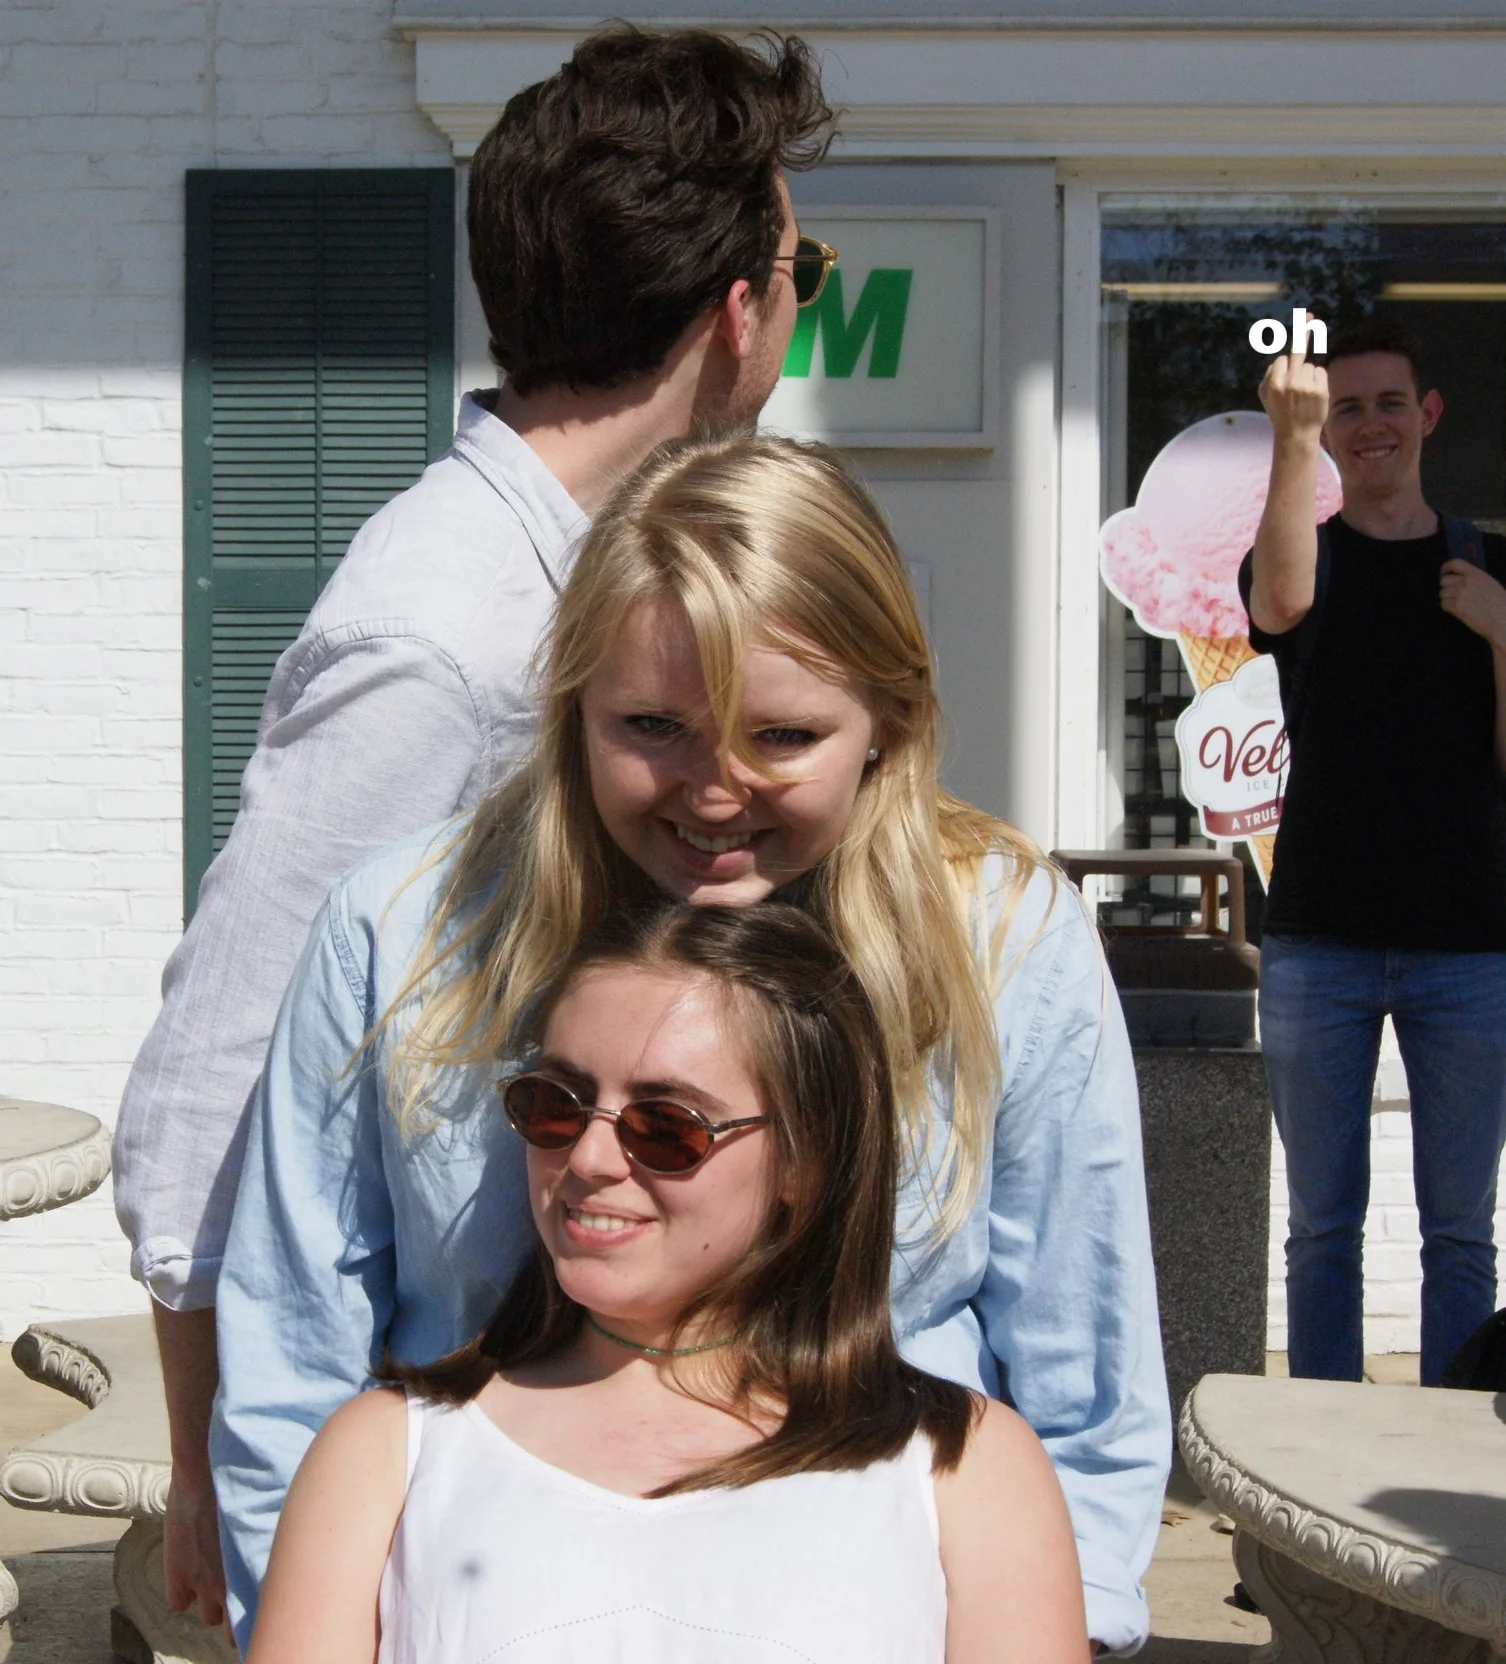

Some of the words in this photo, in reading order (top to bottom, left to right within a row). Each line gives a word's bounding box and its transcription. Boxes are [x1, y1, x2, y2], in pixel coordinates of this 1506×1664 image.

[1246, 779, 1271, 792] ICE
[1231, 816, 1242, 831] A
[1244, 806, 1279, 828] TRUE
